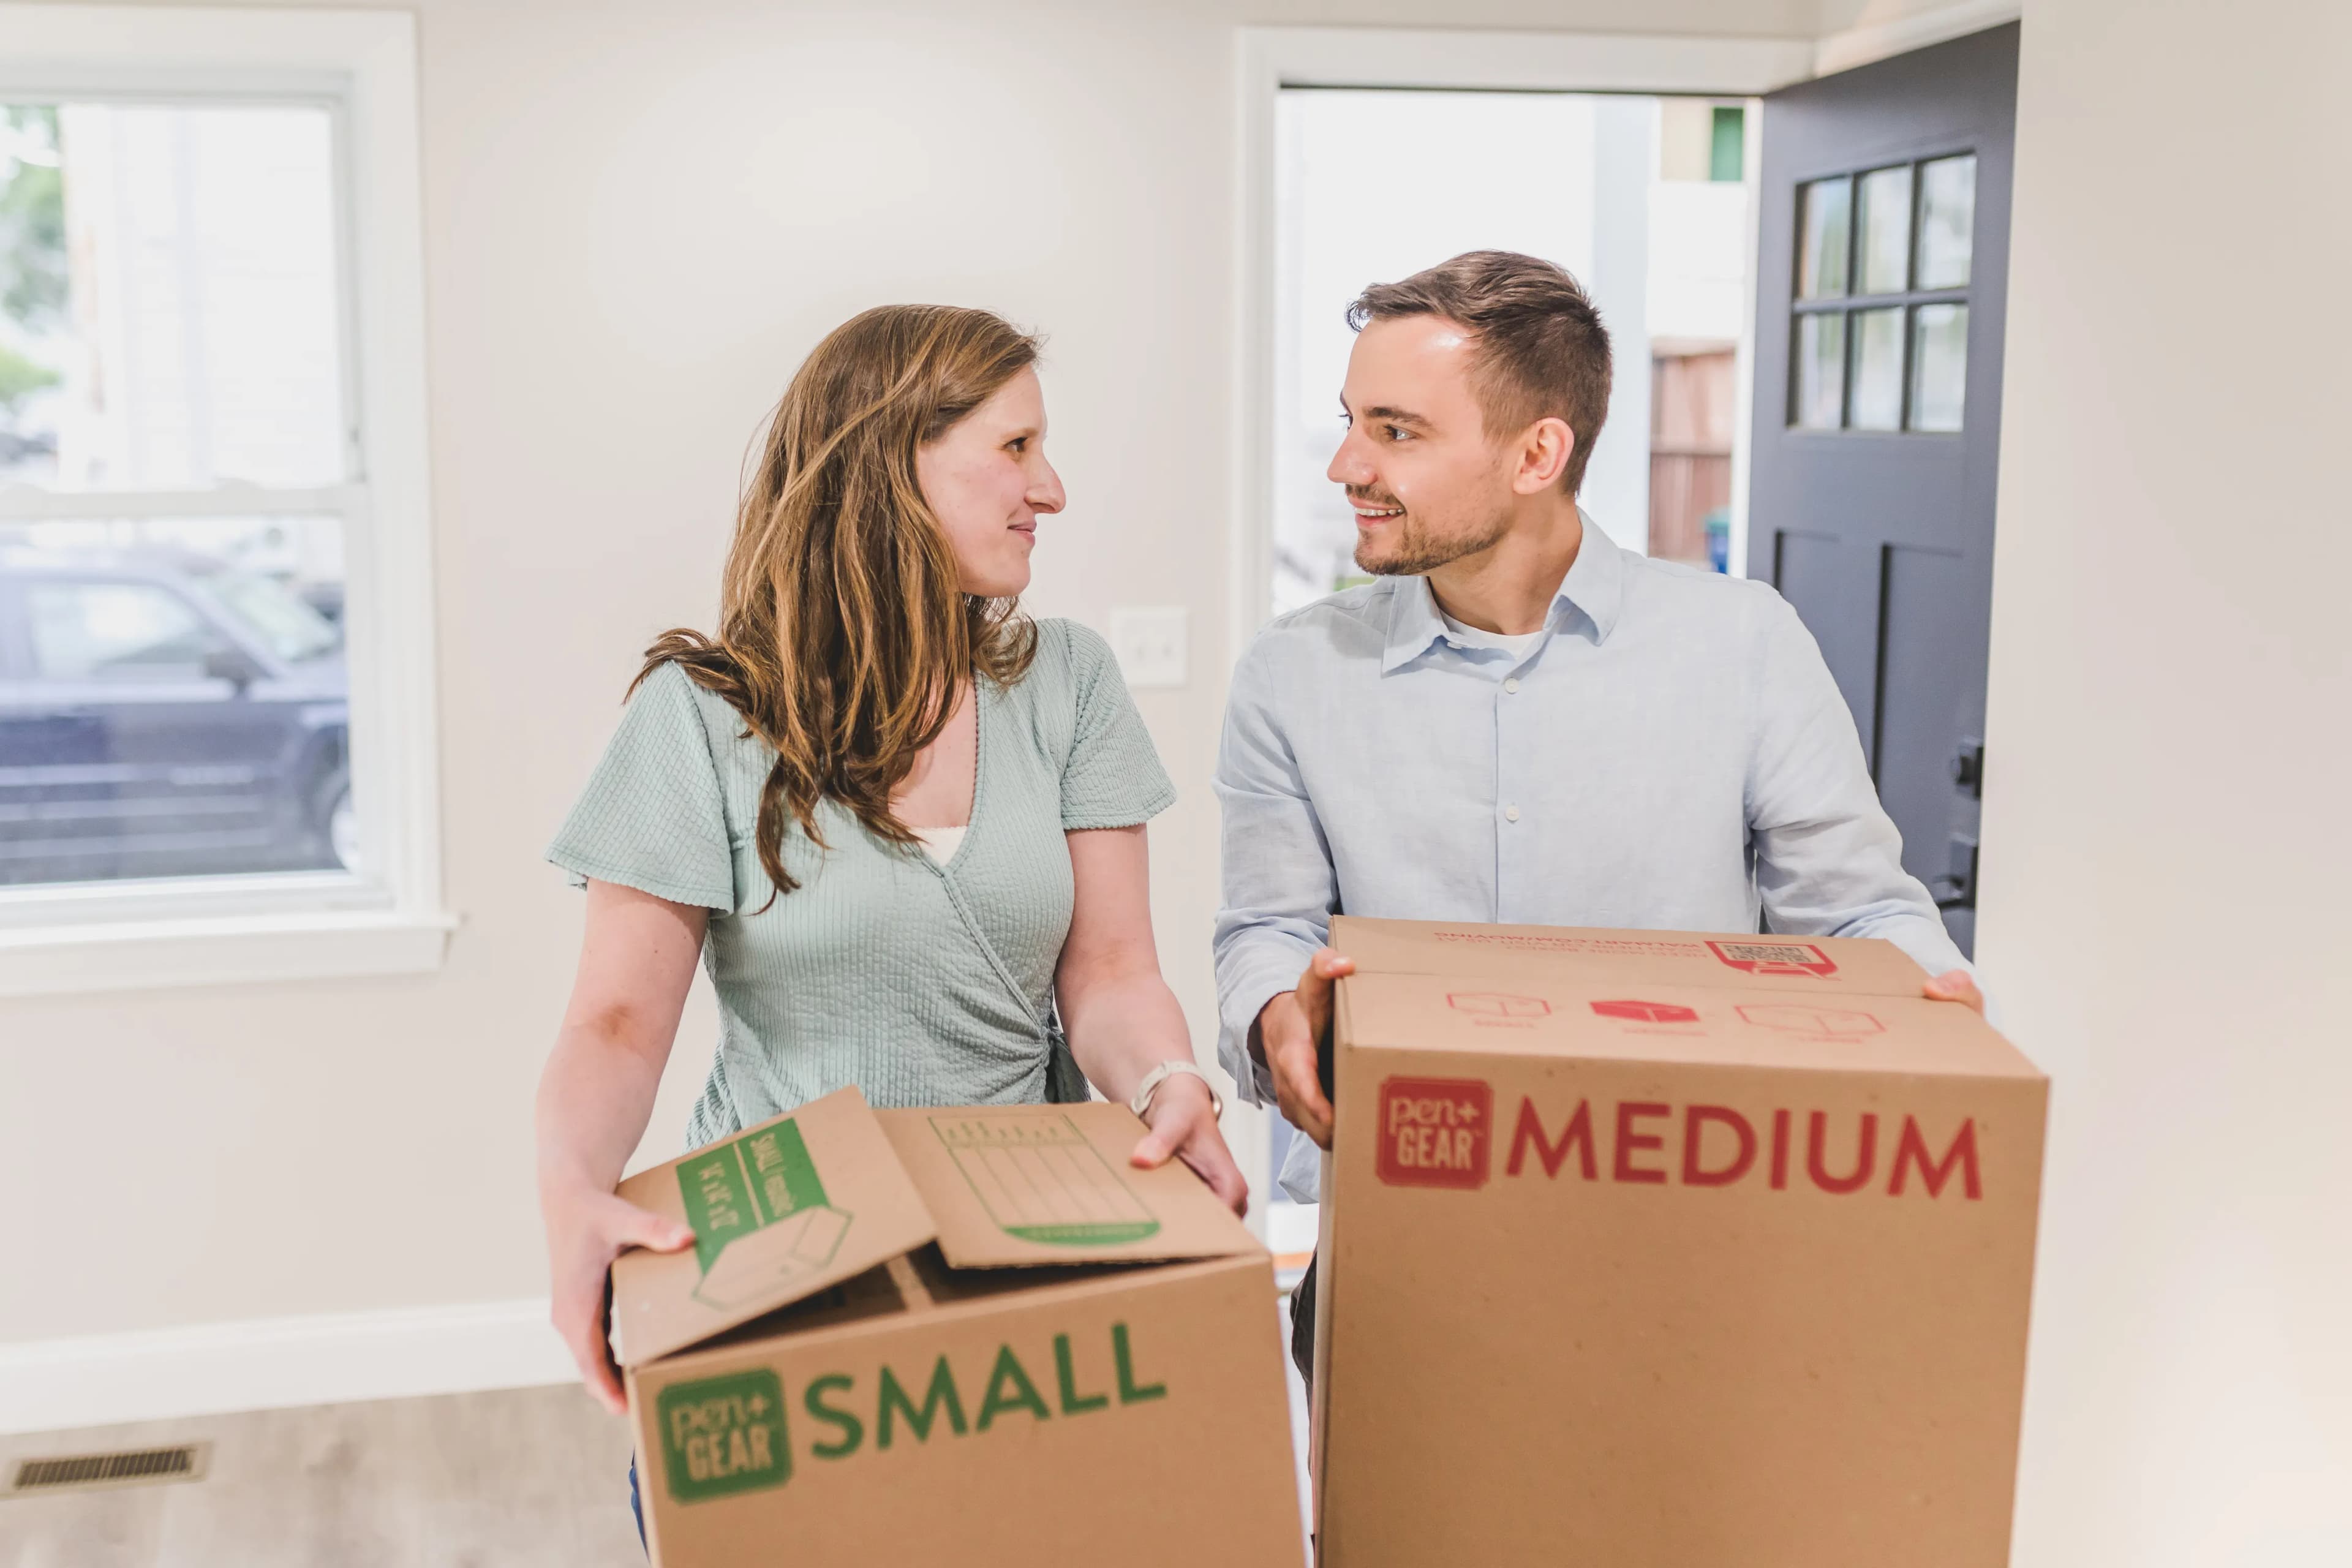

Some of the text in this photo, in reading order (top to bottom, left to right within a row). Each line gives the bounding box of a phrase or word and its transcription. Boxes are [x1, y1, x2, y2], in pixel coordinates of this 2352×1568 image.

[1389, 1096, 1480, 1136] pen+
[1396, 1126, 1473, 1171] GEAR
[1505, 1096, 1983, 1201] MEDIUM
[804, 1322, 1167, 1460] SMALL
[685, 1424, 774, 1482] GEAR
